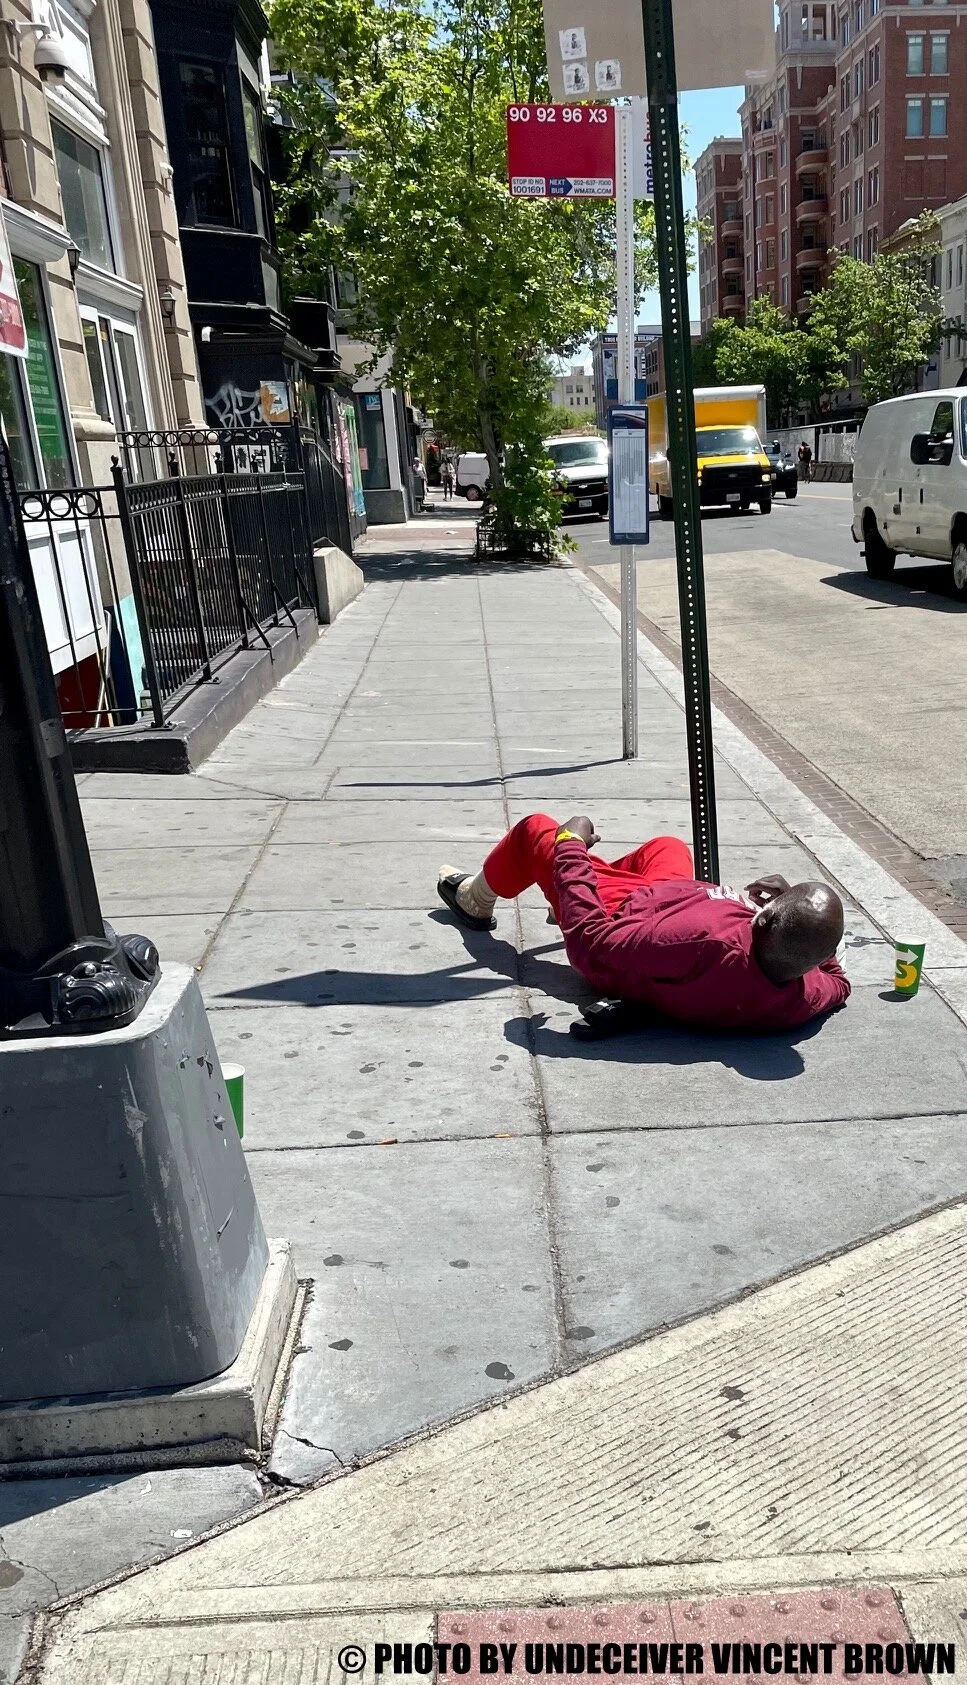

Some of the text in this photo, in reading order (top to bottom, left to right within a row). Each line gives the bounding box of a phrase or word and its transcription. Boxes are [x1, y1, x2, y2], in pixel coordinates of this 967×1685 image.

[509, 107, 608, 123] 90 92 96 X3
[549, 178, 566, 186] NEXT
[513, 185, 545, 194] 1001691
[573, 187, 612, 195] WMATA.COM
